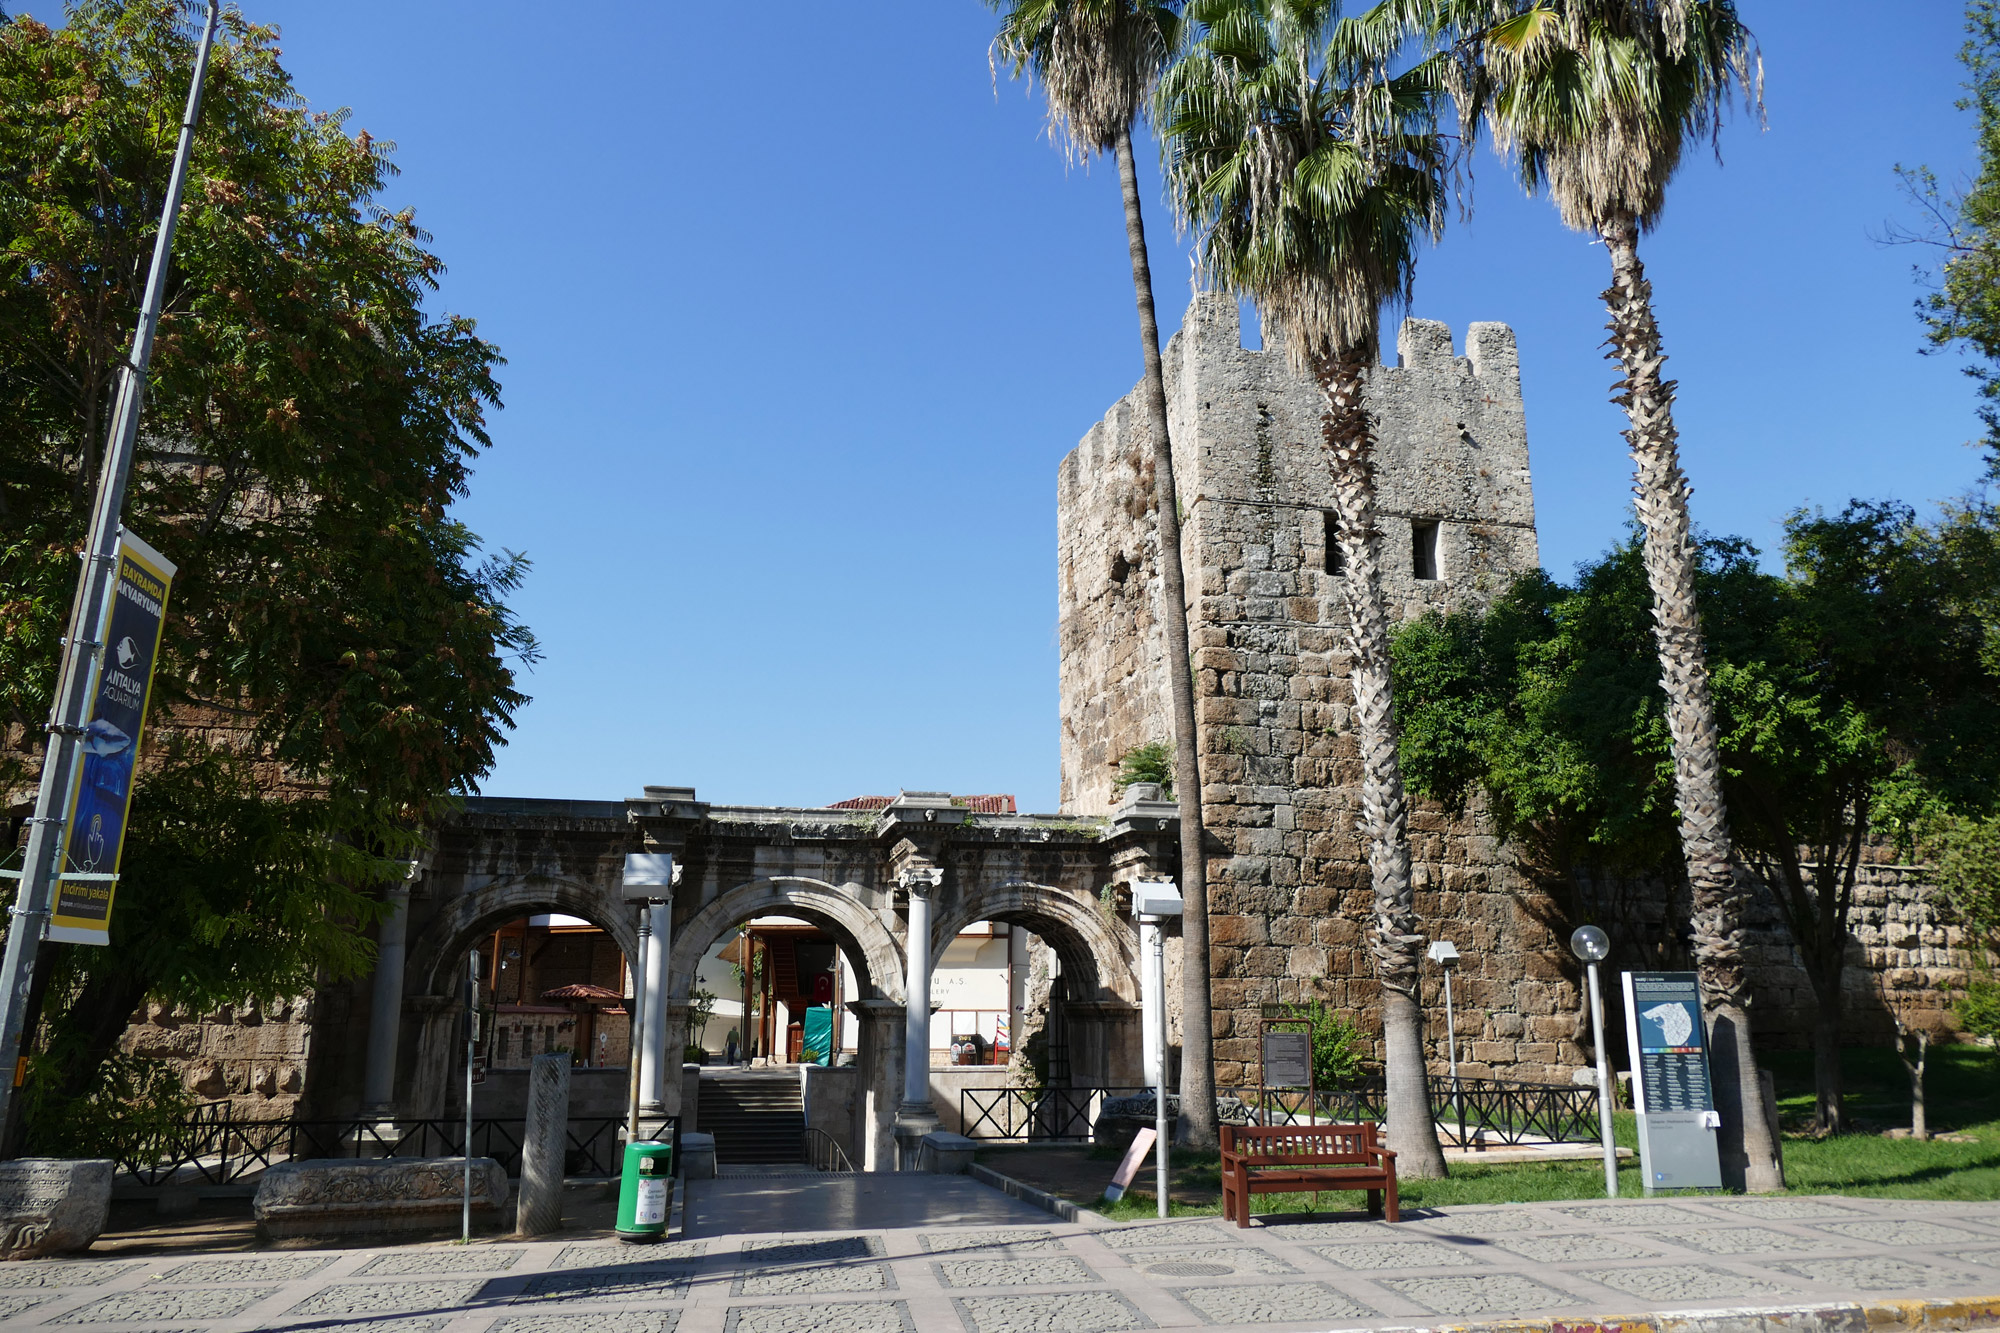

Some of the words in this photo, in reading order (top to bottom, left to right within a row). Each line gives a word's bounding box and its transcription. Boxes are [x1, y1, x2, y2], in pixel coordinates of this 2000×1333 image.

[122, 563, 163, 601] BAYRAMDA
[117, 580, 162, 619] AKVARYUMA
[106, 669, 141, 697] ANTALYA
[102, 685, 140, 711] AQUARIUM
[88, 886, 109, 900] yakala
